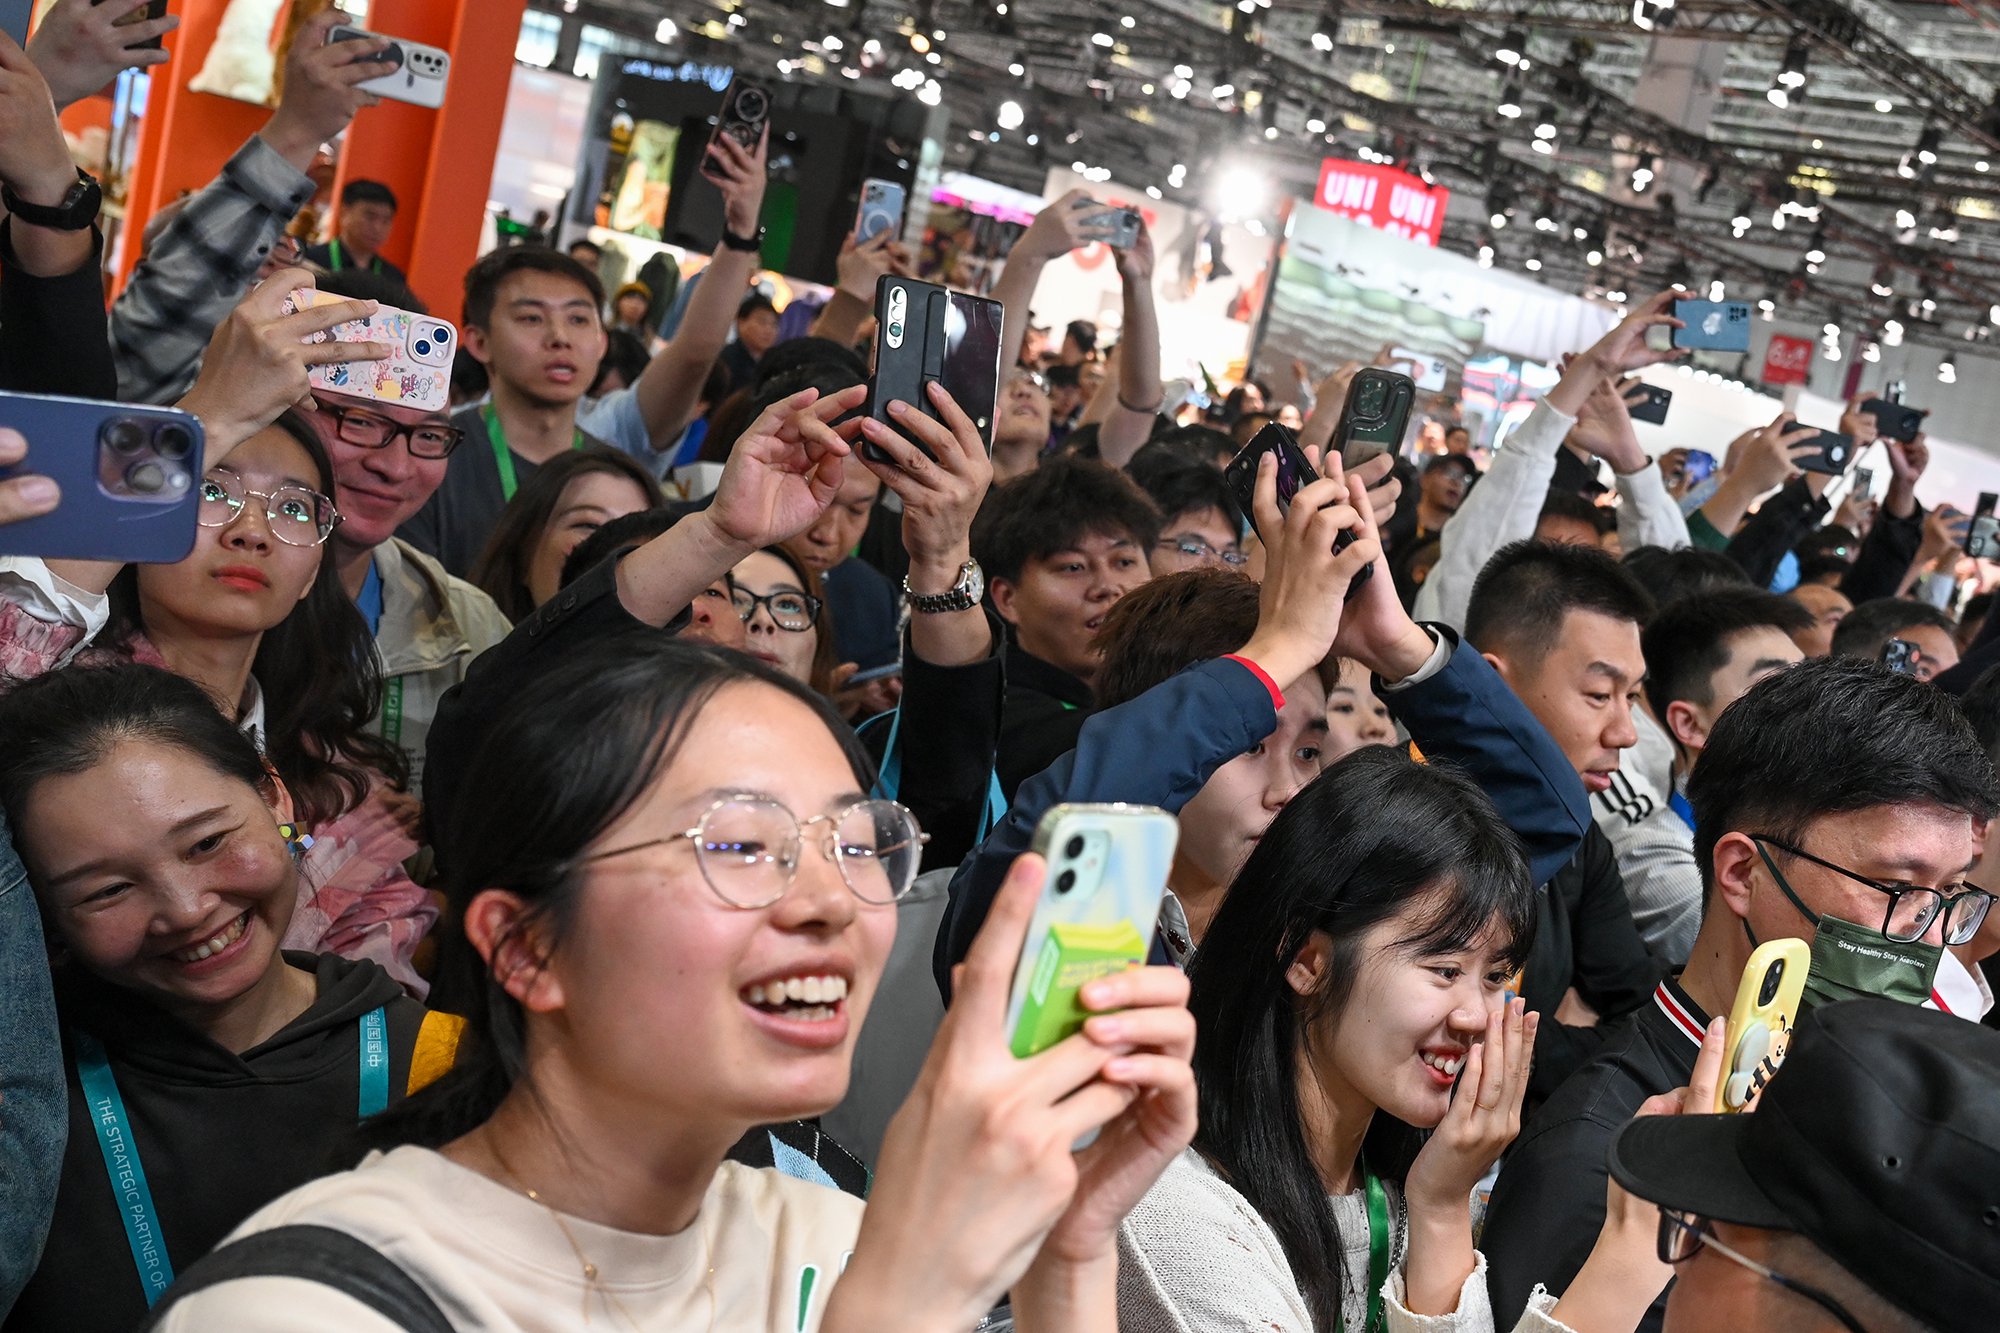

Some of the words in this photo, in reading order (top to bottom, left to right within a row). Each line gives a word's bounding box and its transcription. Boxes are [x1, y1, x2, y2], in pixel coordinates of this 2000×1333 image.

[1324, 170, 1379, 211] UNI
[1389, 183, 1437, 229] UNI
[1838, 941, 1856, 953] Stay
[1857, 947, 1882, 960] Healthy
[1883, 952, 1898, 962] Stay
[97, 1096, 118, 1126] THE
[106, 1126, 140, 1202] STRATEGIC
[129, 1204, 160, 1270] PARTNER
[150, 1271, 168, 1291] OF
